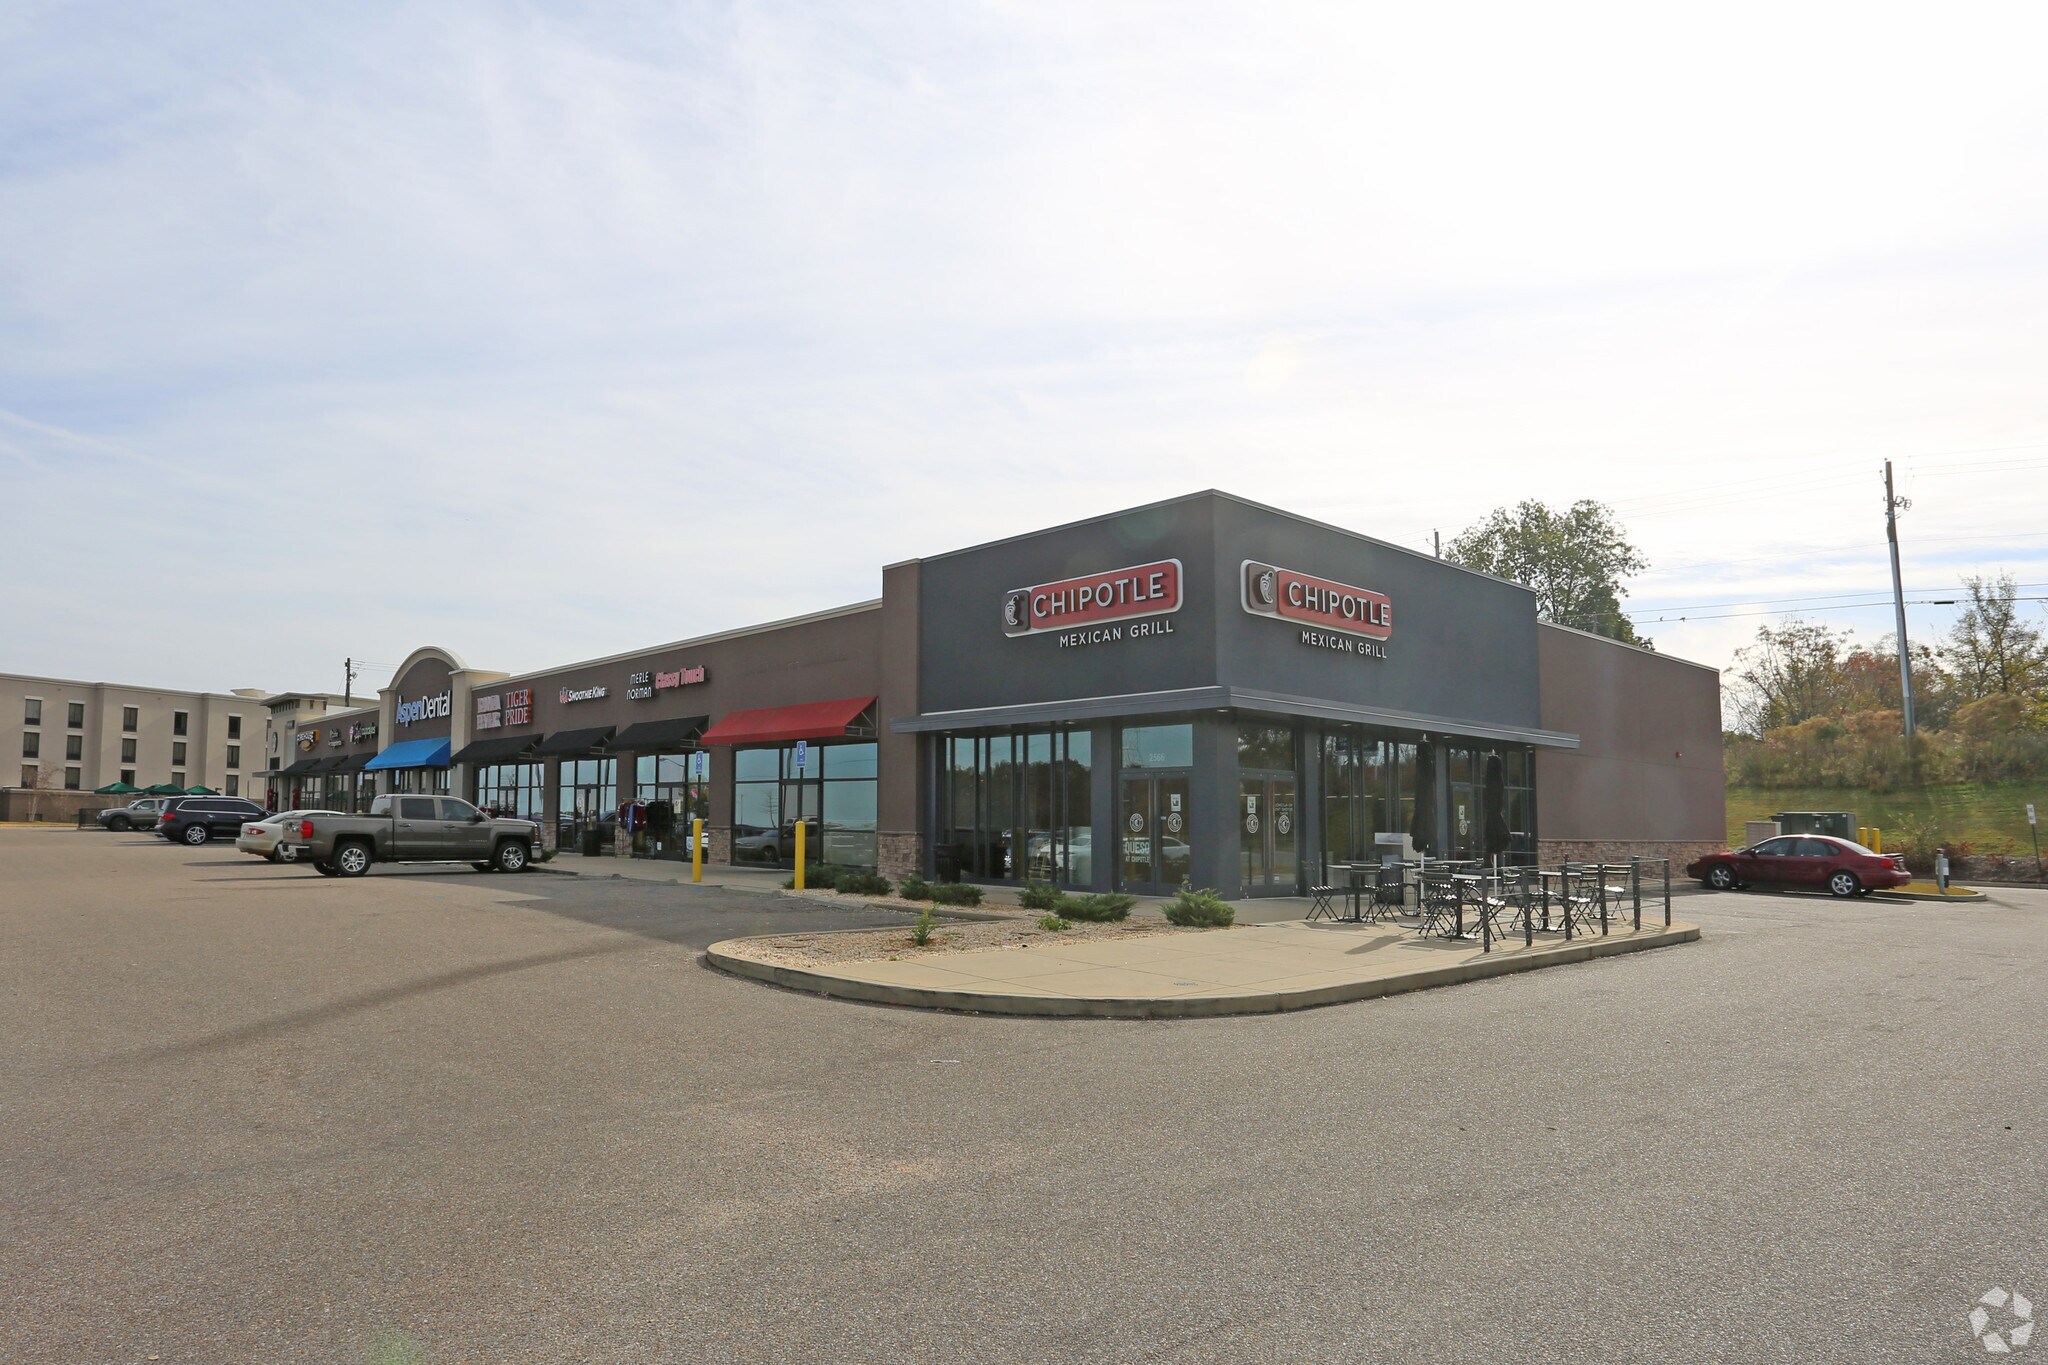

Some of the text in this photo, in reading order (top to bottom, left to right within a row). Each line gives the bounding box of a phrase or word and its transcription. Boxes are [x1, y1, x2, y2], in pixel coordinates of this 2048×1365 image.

[1033, 572, 1165, 618] CHIPOTLE
[1288, 581, 1391, 627] CHIPOTLE
[1059, 620, 1174, 648] MEXICAN GRILL
[1302, 630, 1387, 659] MEXICAN GRILL
[505, 688, 530, 709] TIGER
[505, 707, 529, 726] PRIDE
[1125, 841, 1150, 855] QUESO
